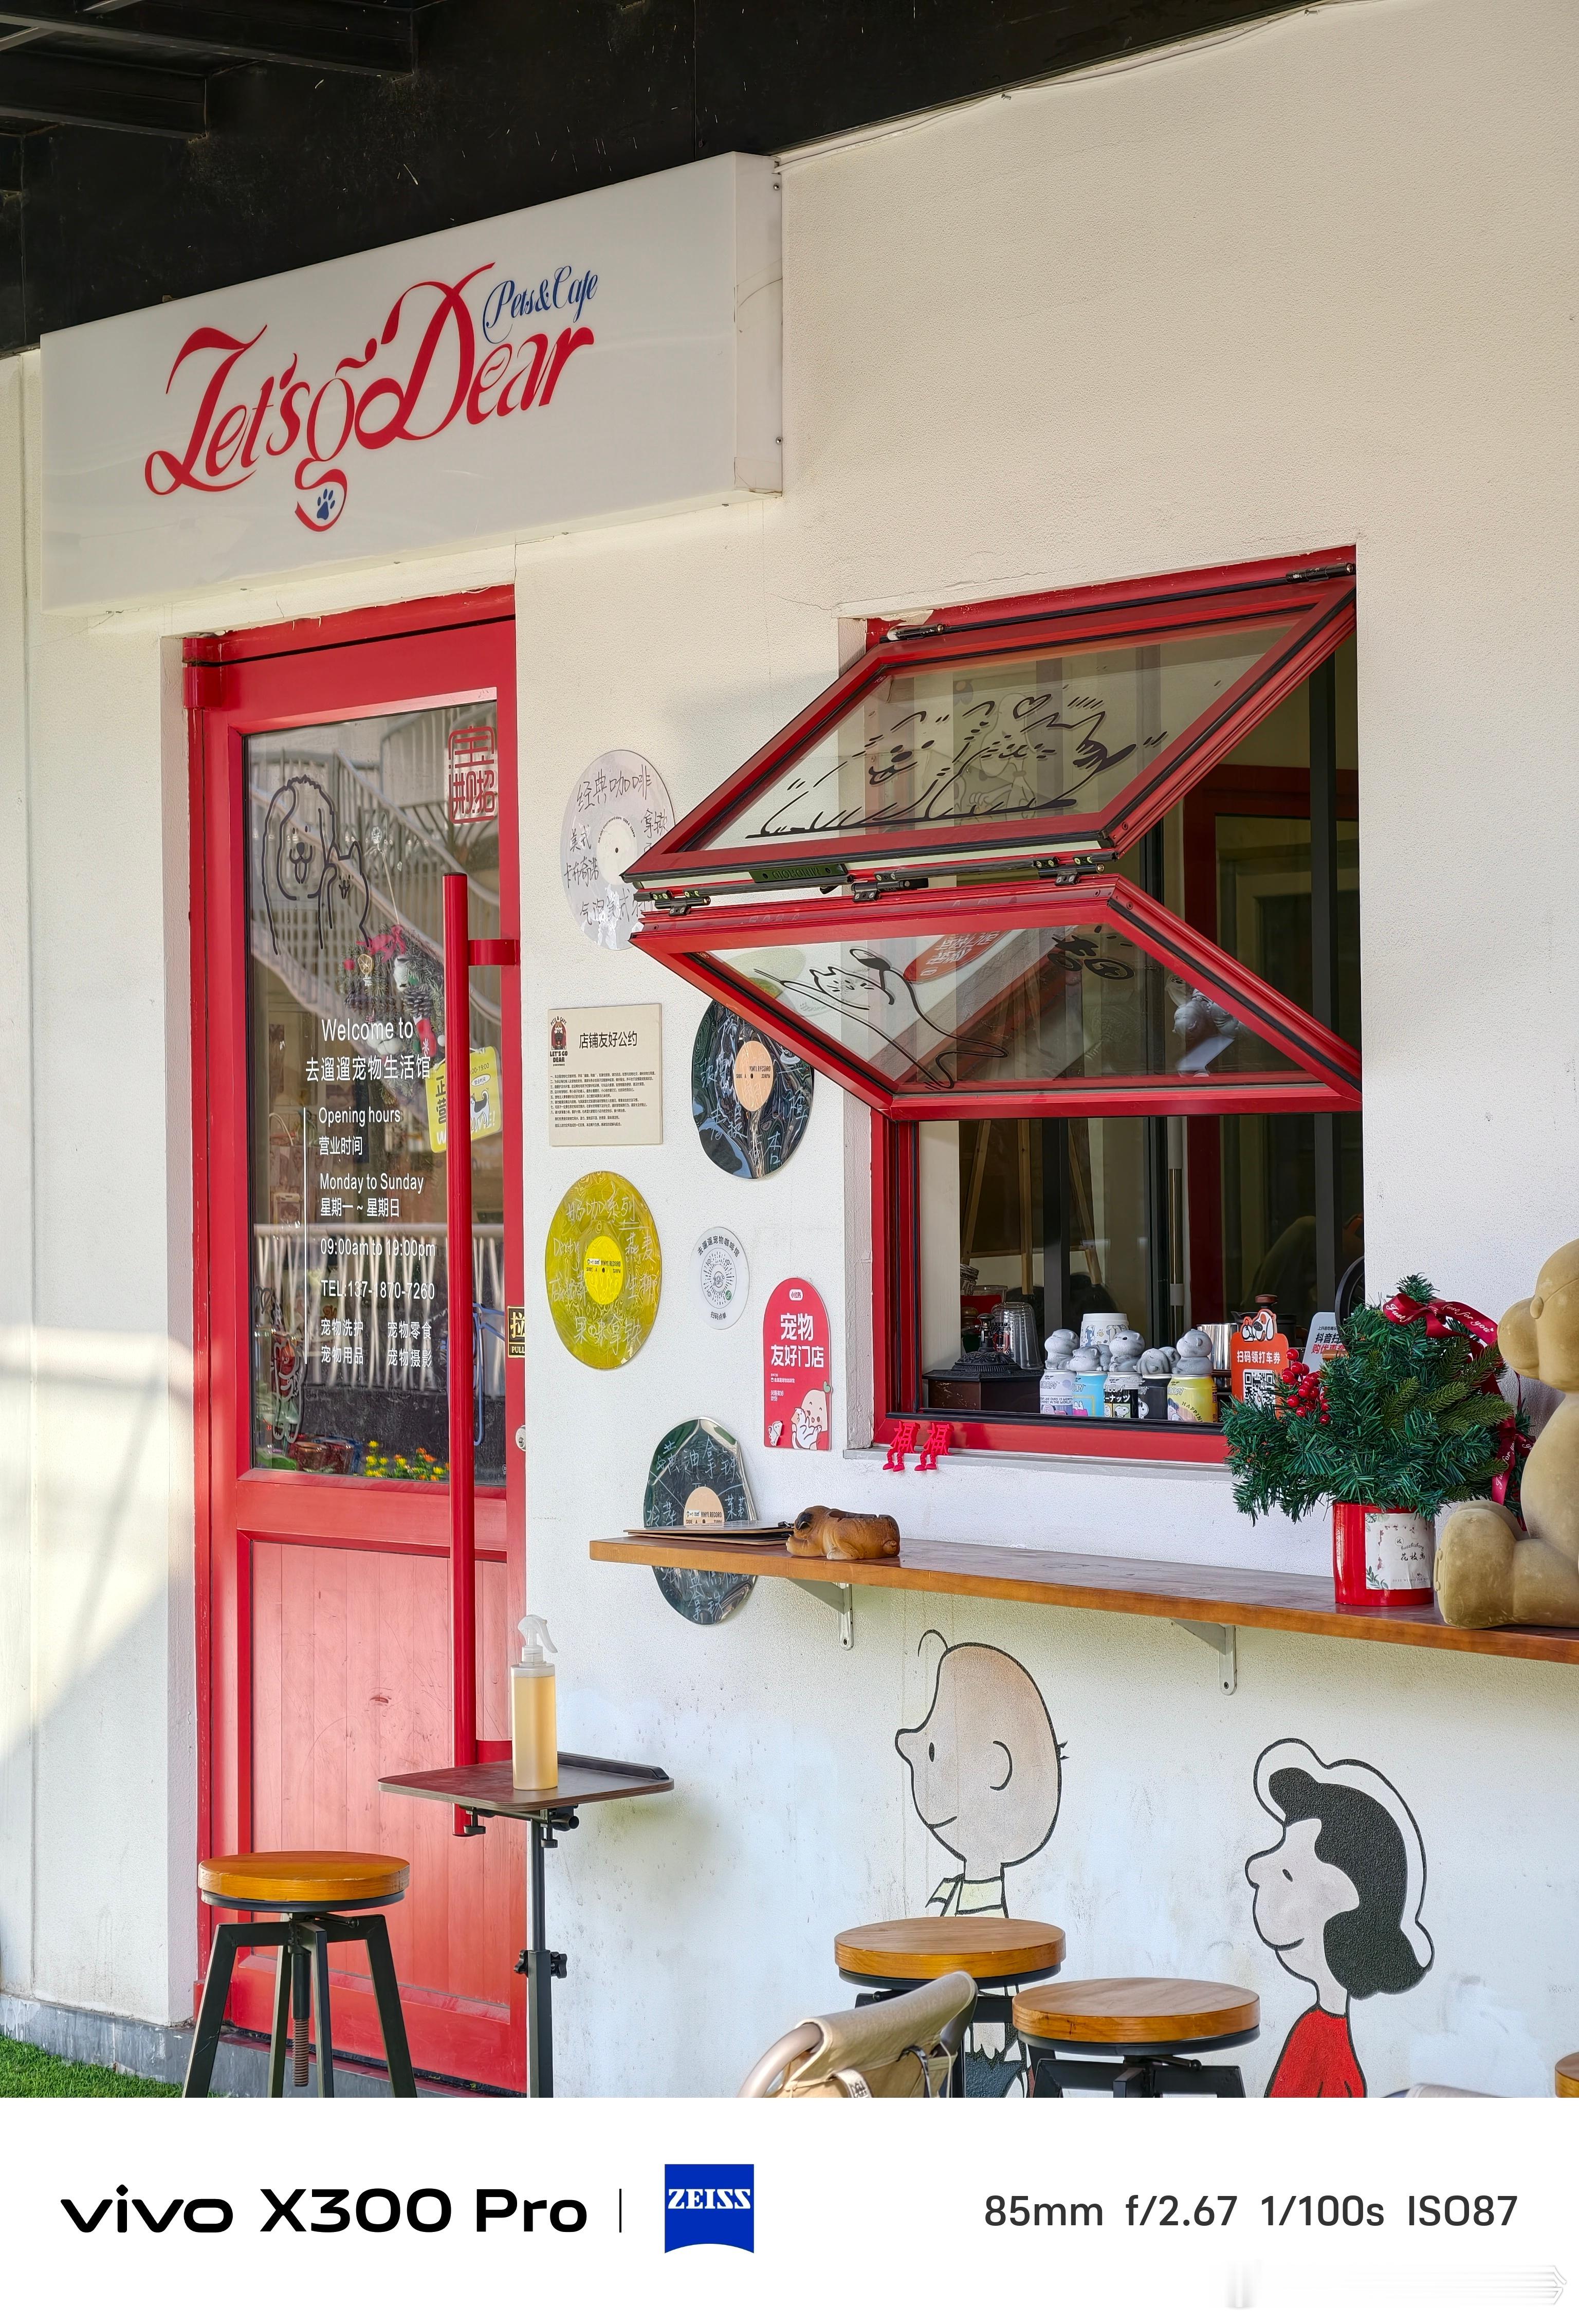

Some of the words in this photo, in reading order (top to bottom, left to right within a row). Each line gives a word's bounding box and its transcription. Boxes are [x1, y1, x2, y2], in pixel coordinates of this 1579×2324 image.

[577, 764, 652, 812] 经典咖啡
[570, 825, 592, 852] 美式
[564, 856, 599, 888] 卡布奇诺
[321, 1018, 394, 1041] Welcome
[399, 1016, 413, 1039] to
[579, 1031, 637, 1049] 店铺友好公约
[305, 1055, 431, 1082] 去遛遛宠物生活馆
[471, 1062, 489, 1075] :00-19:00
[319, 1107, 365, 1127] Opening
[369, 1107, 400, 1122] hours
[319, 1136, 362, 1156] 营业时间
[320, 1173, 364, 1194] Monday
[366, 1174, 377, 1190] to
[380, 1173, 424, 1194] Sunday
[320, 1197, 353, 1218] 星期一
[366, 1197, 399, 1218] 星期日
[320, 1238, 369, 1256] 09:00am
[372, 1240, 382, 1256] to
[386, 1240, 436, 1260] 19:00pm
[321, 1280, 435, 1300] TEL:137-1870-7260
[510, 1312, 525, 1338] 拉
[710, 1311, 727, 1320] 扫码点单
[1460, 1312, 1474, 1320] for
[1471, 1321, 1491, 1333] you
[320, 1318, 363, 1337] 宠物洗护
[388, 1321, 432, 1340] 宠物零食
[780, 1313, 814, 1341] 宠物
[1314, 1333, 1342, 1343] 抖音扫
[320, 1345, 363, 1365] 宠物用品
[388, 1349, 432, 1368] 宠物摄影
[770, 1344, 824, 1368] 友好门店
[1237, 1350, 1281, 1365] 扫码领打车券
[1182, 1402, 1203, 1422] HAPPIN
